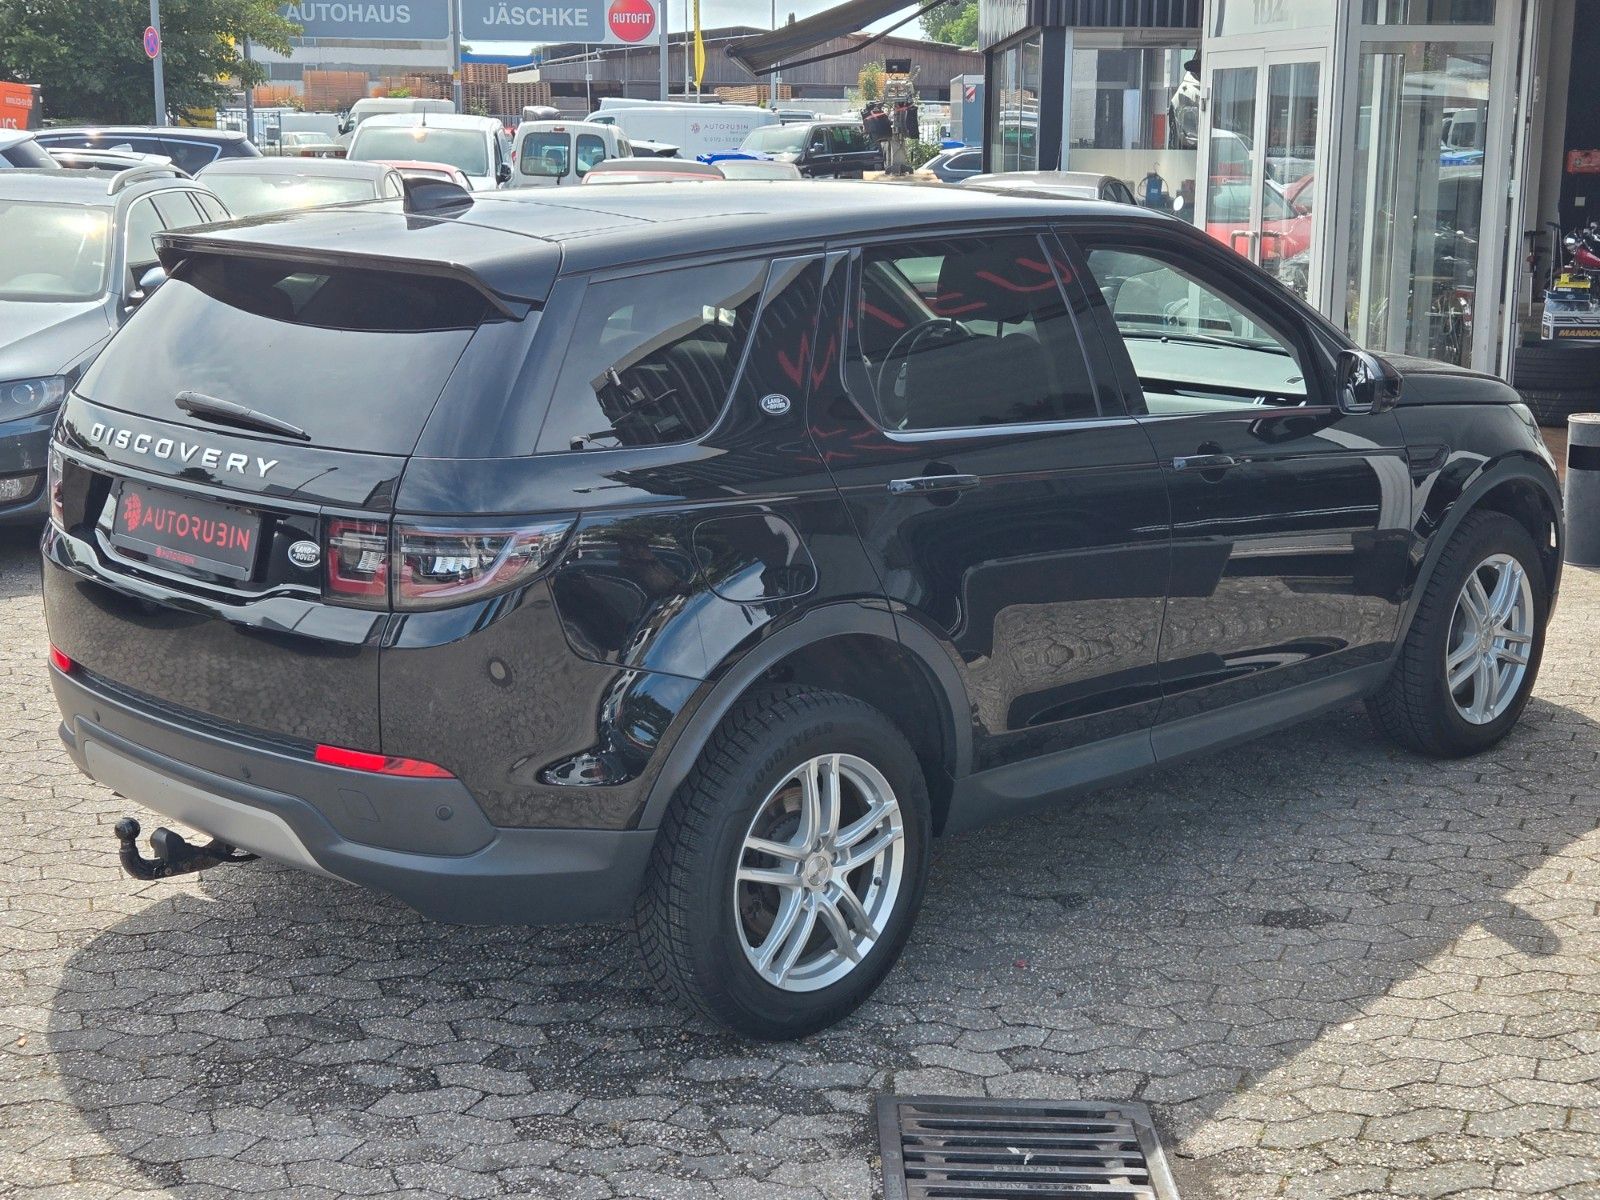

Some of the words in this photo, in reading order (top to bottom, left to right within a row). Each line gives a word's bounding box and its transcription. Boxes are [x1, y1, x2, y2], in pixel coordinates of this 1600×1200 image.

[286, 2, 411, 23] AUTOHAUS
[482, 3, 589, 26] JÄSCHKE
[612, 13, 651, 24] AUTOFIT
[1253, 0, 1289, 24] 102
[1558, 329, 1600, 337] MANNO
[90, 423, 280, 477] DISCOVERY
[142, 506, 251, 553] AUTORUBIN
[295, 545, 312, 554] LAND
[296, 552, 316, 562] ROVER
